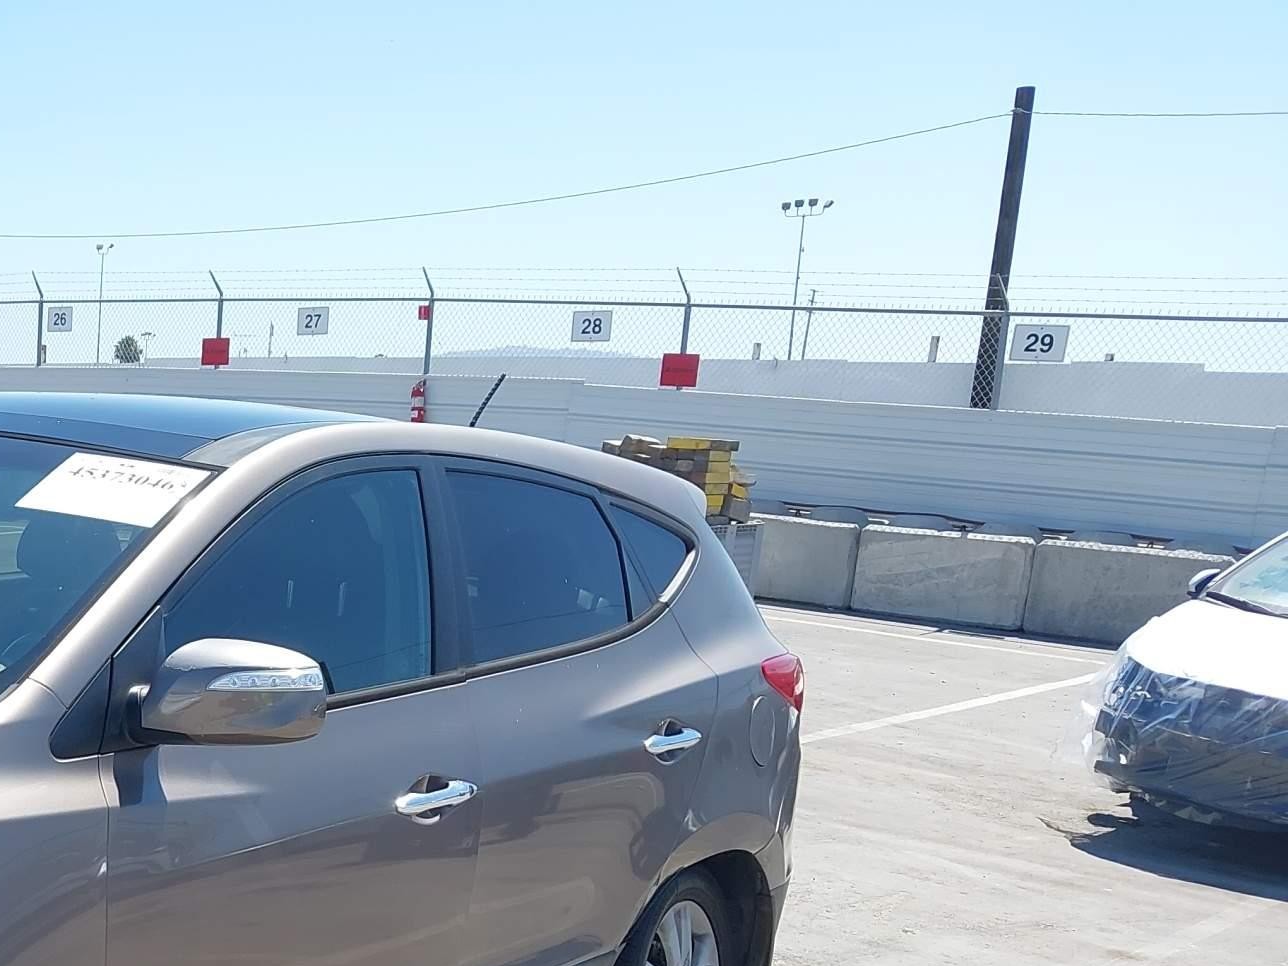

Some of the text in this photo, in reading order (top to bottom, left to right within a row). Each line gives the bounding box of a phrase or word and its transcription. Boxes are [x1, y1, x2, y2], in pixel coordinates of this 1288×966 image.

[53, 312, 67, 327] 26
[304, 314, 322, 329] 27
[580, 318, 603, 335] 28
[1023, 333, 1055, 354] 29
